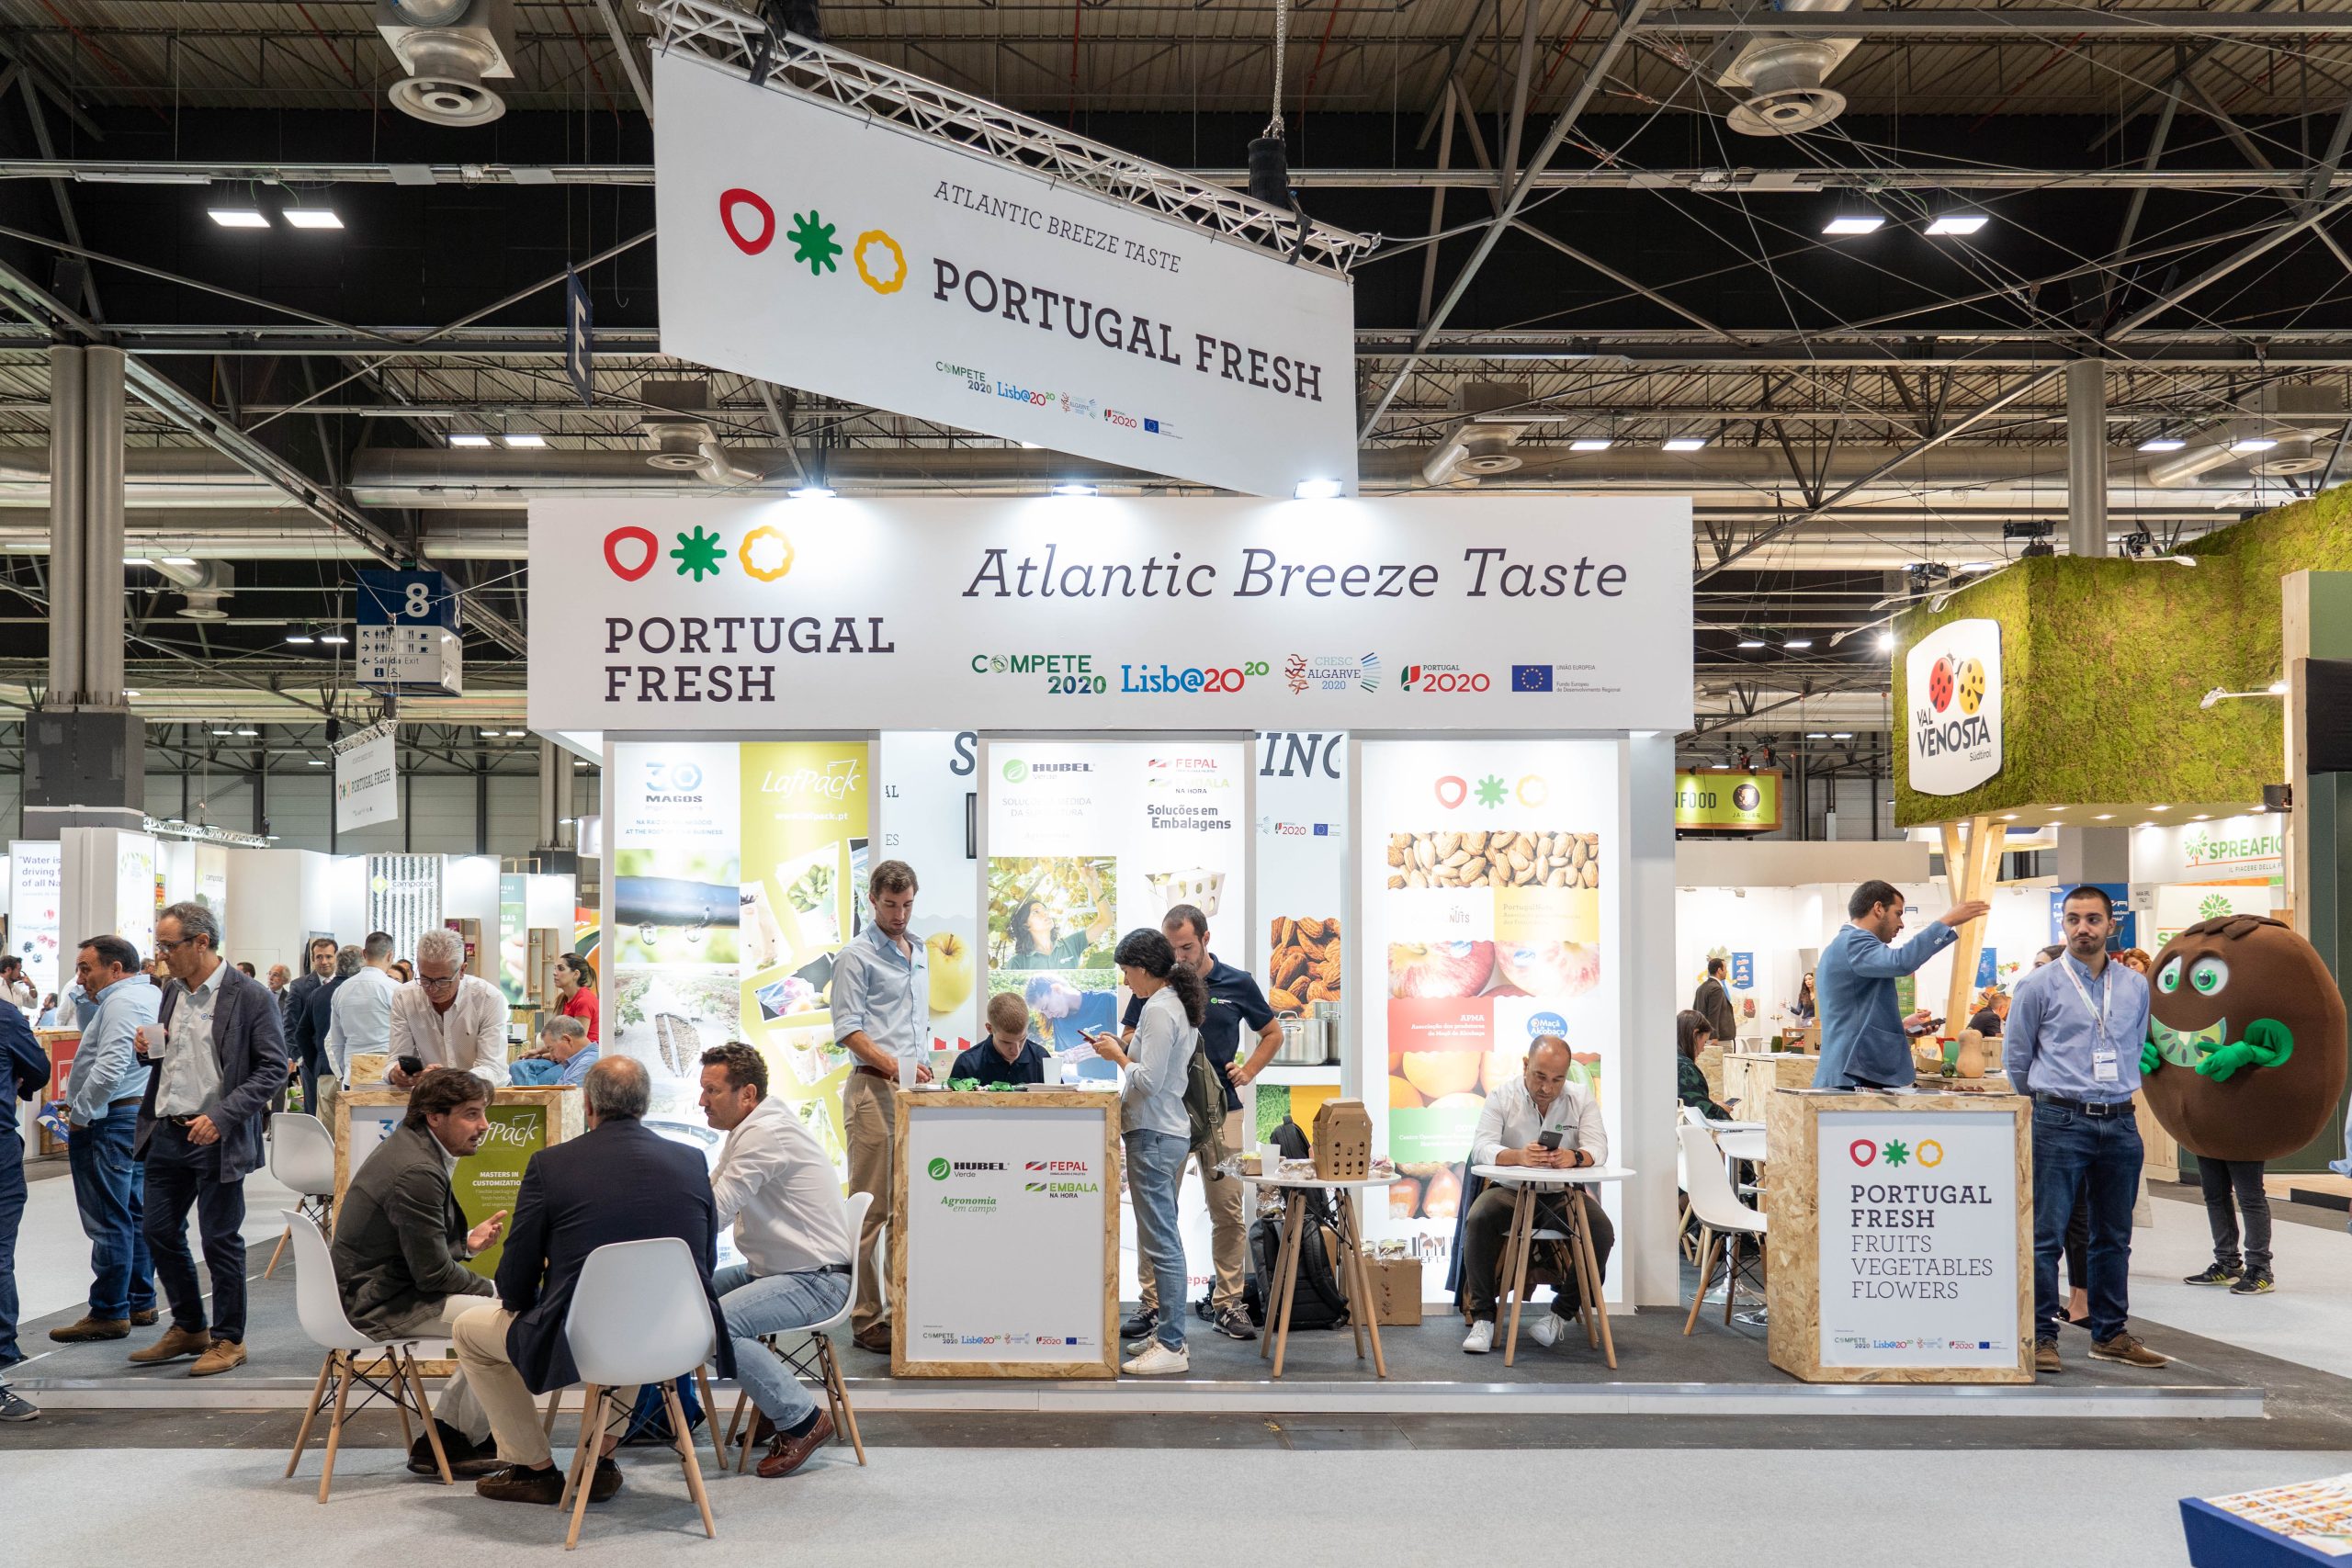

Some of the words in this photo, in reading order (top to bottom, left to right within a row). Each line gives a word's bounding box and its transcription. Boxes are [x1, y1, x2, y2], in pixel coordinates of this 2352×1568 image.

[933, 181, 1042, 230] ATLANTIC
[1047, 216, 1119, 254] BREEZE
[1125, 241, 1181, 273] TASTE
[933, 257, 1181, 366] PORTUGAL
[1195, 333, 1322, 402] FRESH
[967, 379, 991, 394] 2020
[1113, 414, 1137, 429] 2020
[2132, 535, 2147, 546] 24
[962, 544, 1216, 598] Atlantic
[1234, 548, 1439, 598] Breeze
[1464, 547, 1626, 598] Taste
[405, 582, 429, 617] 8
[605, 617, 895, 654] PORTUGAL
[375, 657, 401, 665] Salida
[971, 654, 1091, 673] COMPETE
[1315, 656, 1353, 666] CRESC
[1307, 669, 1361, 679] ALGARVE
[605, 666, 775, 703] FRESH
[1047, 675, 1107, 694] 2020
[1322, 681, 1346, 690] 2020
[1423, 673, 1490, 693] 2020
[1917, 707, 1933, 727] VAL
[1917, 714, 1991, 760] VENOSTA
[1255, 732, 1343, 779] IN
[1032, 763, 1093, 773] HUBEL
[1176, 759, 1217, 768] FEPAL
[761, 760, 861, 799] LafPack
[646, 795, 702, 803] MAGOS
[1201, 807, 1218, 816] em
[1151, 817, 1231, 831] Embalagens
[1282, 826, 1306, 835] 2020
[886, 833, 899, 846] ES
[22, 867, 54, 877] driving
[22, 879, 31, 887] of
[391, 878, 434, 888] campotec
[1449, 911, 1470, 924] NUTS
[1540, 1019, 1560, 1028] Maçã
[478, 1113, 538, 1147] fPack
[954, 1162, 1008, 1170] HUBEL
[1050, 1161, 1088, 1171] FEPAL
[1049, 1182, 1098, 1192] EMBALA
[941, 1196, 997, 1207] Agronomia
[1851, 1185, 1992, 1204] PORTUGAL
[968, 1205, 997, 1214] campo
[1851, 1209, 1934, 1228] FRESH
[1851, 1235, 1932, 1253] FRUITS
[1851, 1258, 1993, 1276] VEGETABLES
[1851, 1280, 1959, 1299] FLOWERS
